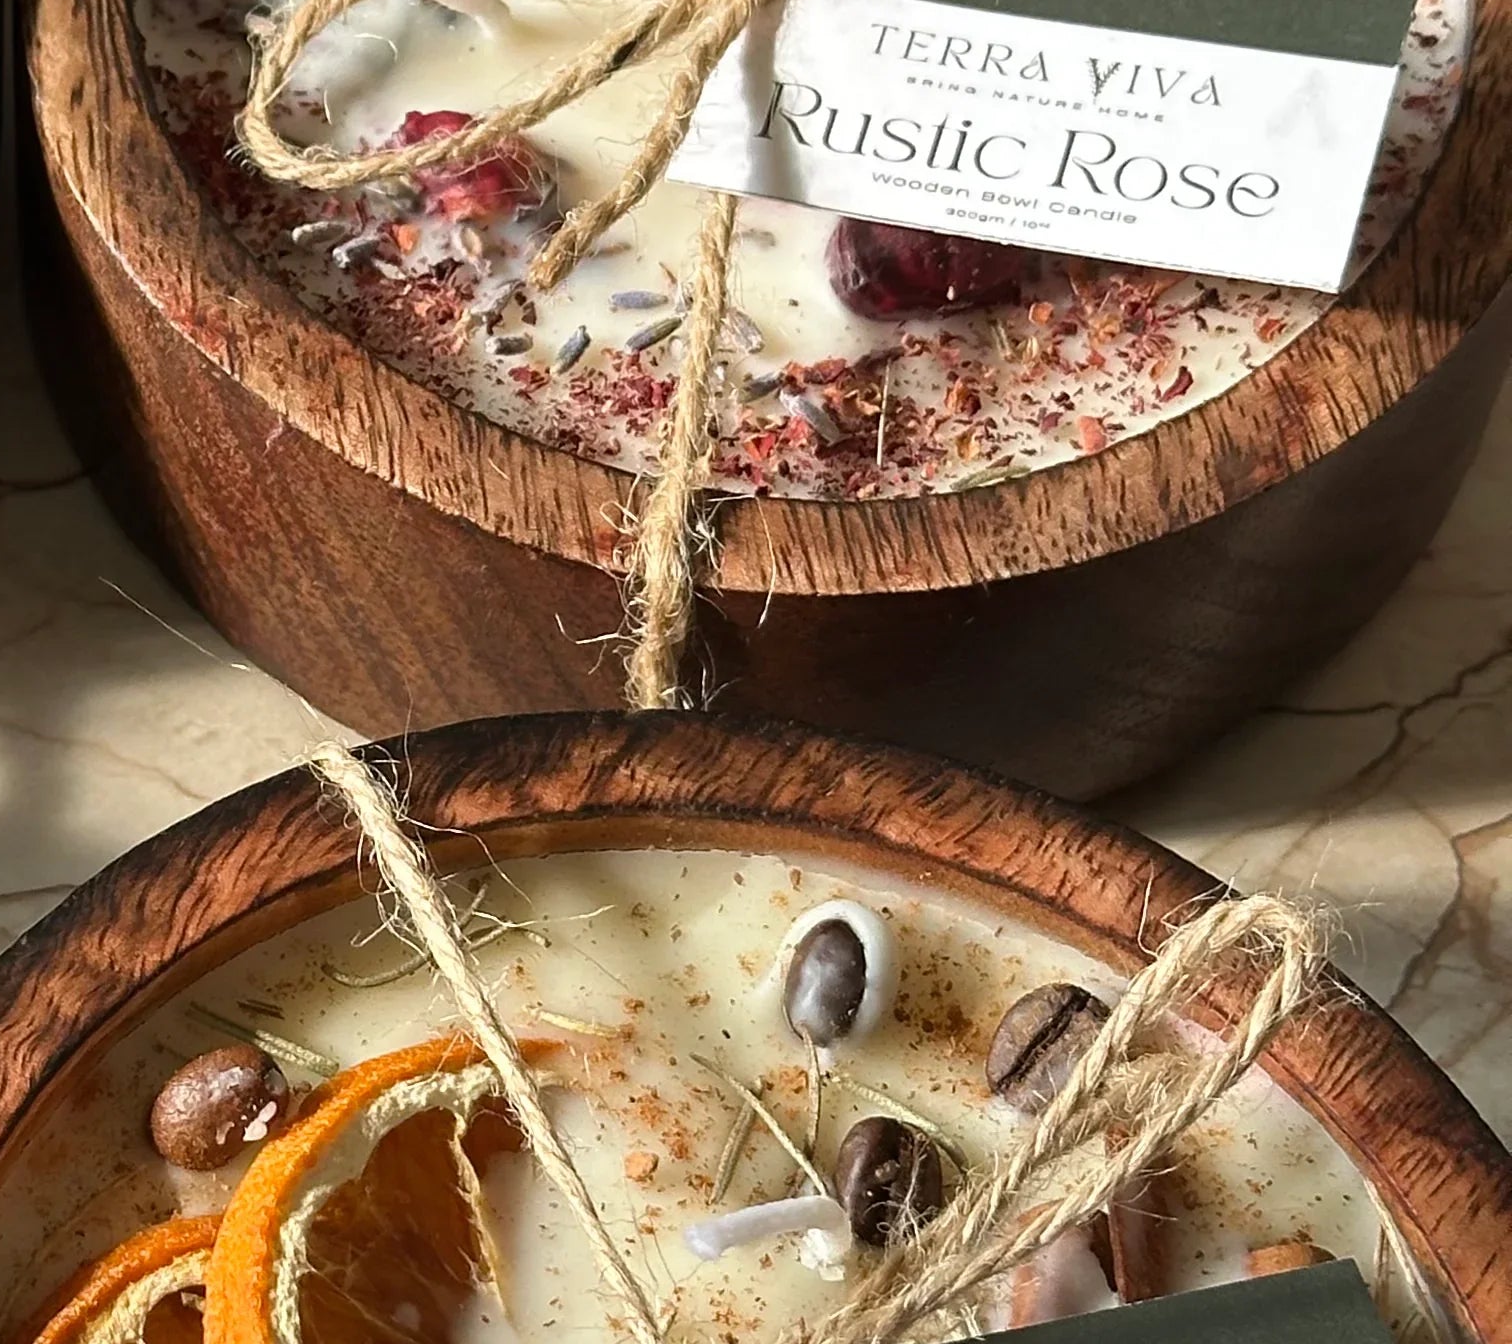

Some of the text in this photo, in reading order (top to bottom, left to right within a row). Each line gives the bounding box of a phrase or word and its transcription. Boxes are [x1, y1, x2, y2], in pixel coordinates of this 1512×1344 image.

[869, 22, 1223, 107] TERRA VIVA
[905, 76, 1165, 123] BRING NATURE HOME
[753, 80, 1281, 219] Rustic Rose
[871, 171, 1138, 225] Wooden Bowl Candle
